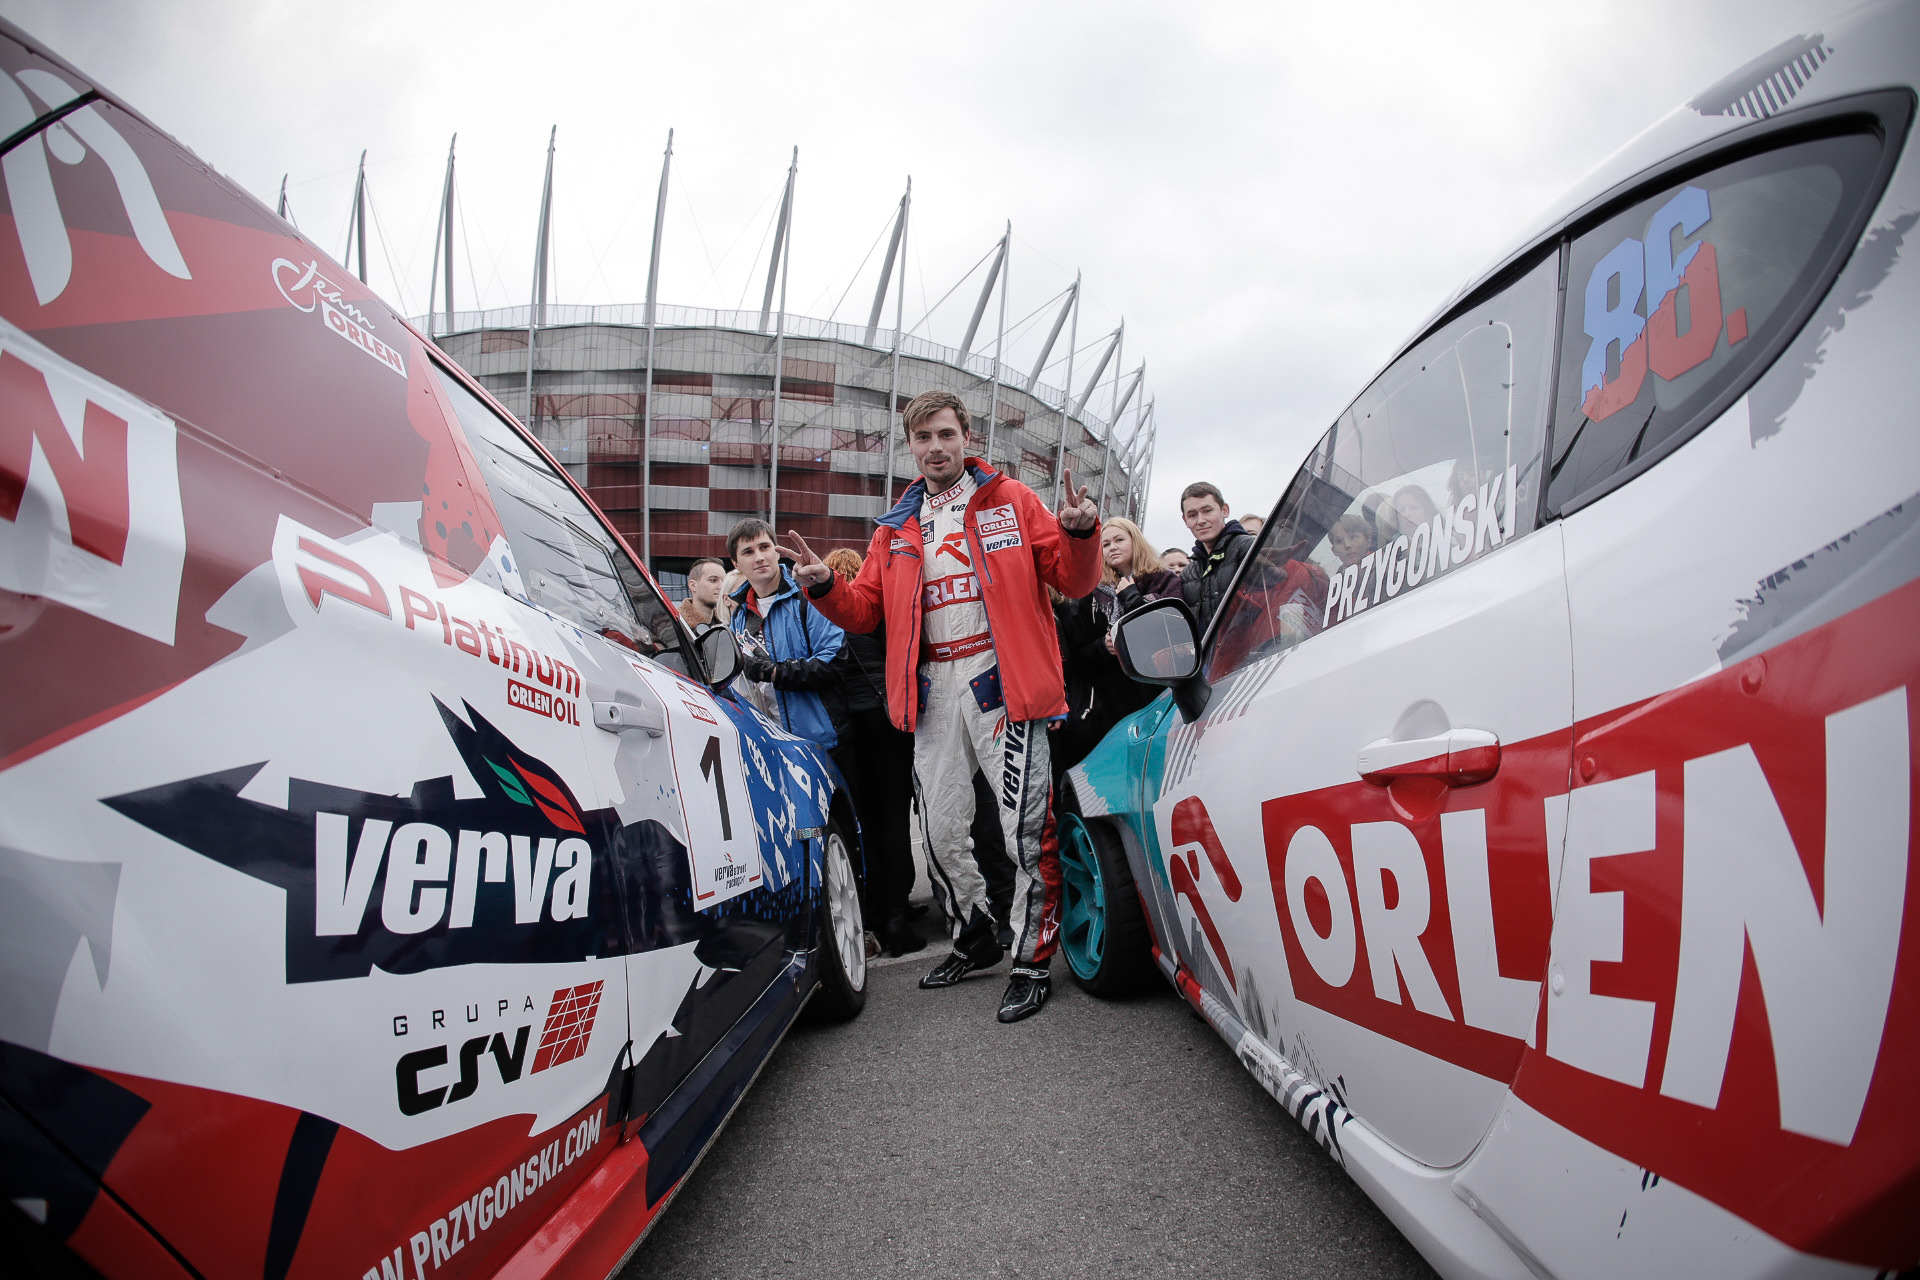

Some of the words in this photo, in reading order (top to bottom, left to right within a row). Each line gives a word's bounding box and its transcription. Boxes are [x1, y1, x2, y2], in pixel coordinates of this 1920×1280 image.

[272, 258, 375, 329] Team
[328, 310, 403, 371] ORLEN
[931, 486, 962, 506] ORLEN
[983, 519, 1014, 532] ORLEN
[986, 537, 1020, 551] verva
[924, 575, 981, 607] RLEN
[399, 585, 581, 698] Platinum
[509, 683, 550, 714] ORLEN
[554, 697, 581, 726] OIL
[700, 736, 732, 841] 1
[1003, 721, 1026, 811] verva
[315, 811, 592, 936] verva
[714, 864, 734, 882] verva
[1284, 684, 1911, 1148] ORLEN
[393, 995, 534, 1036] GRUPA
[396, 1025, 532, 1117] CSV
